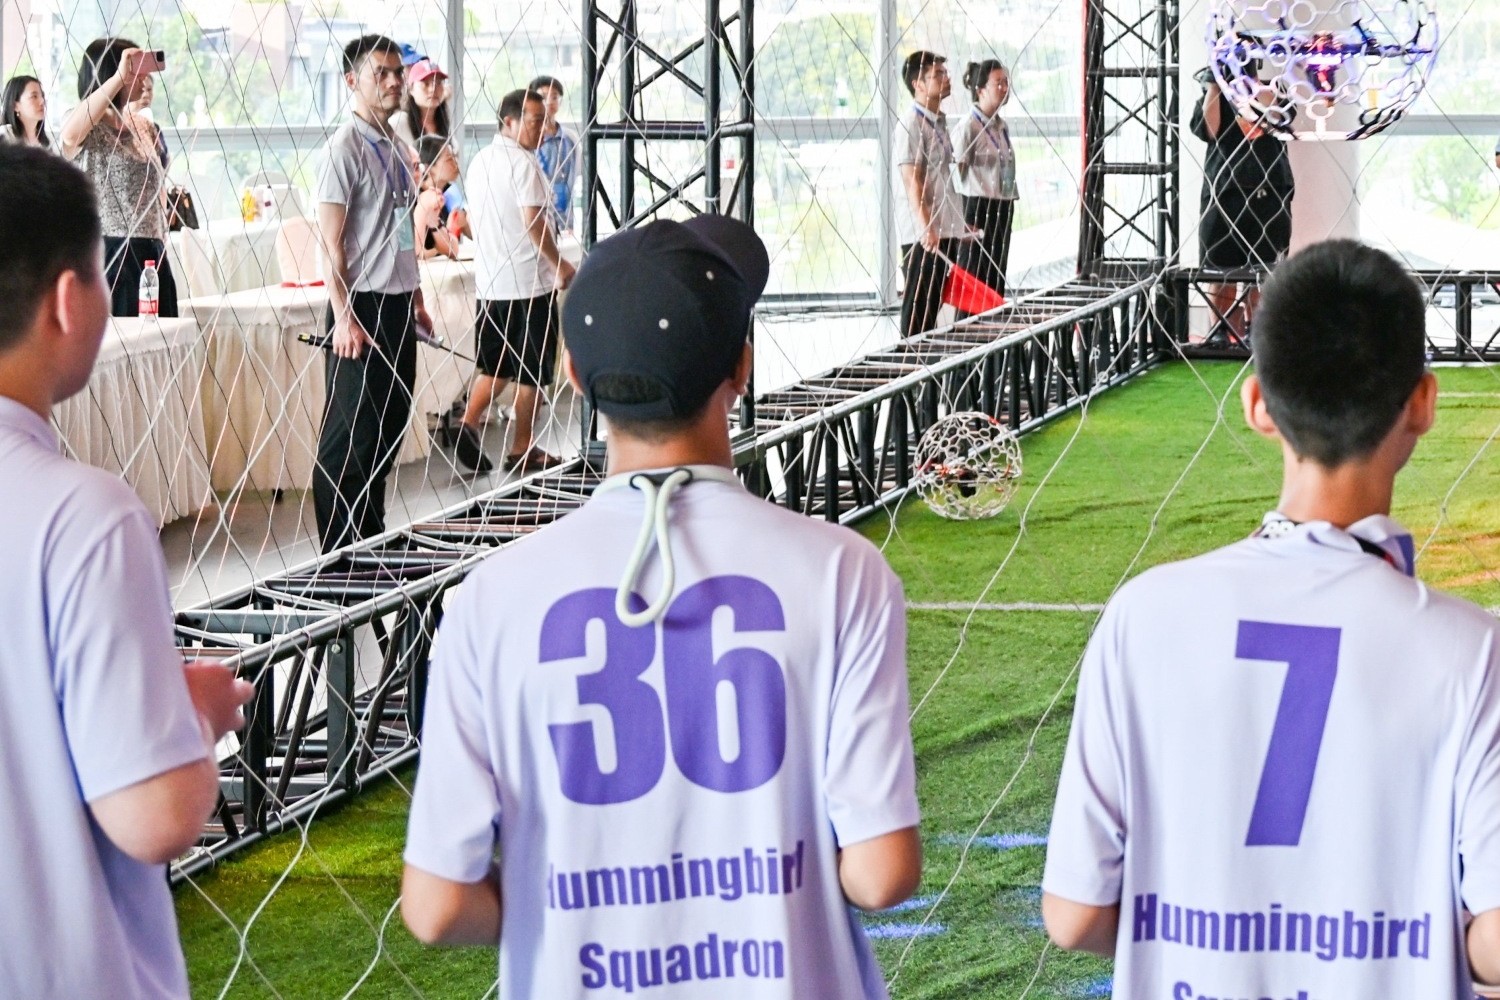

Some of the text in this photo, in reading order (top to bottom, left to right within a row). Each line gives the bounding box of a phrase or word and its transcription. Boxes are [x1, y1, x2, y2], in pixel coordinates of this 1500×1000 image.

[538, 574, 787, 805] 36
[1235, 620, 1342, 847] 7
[579, 933, 785, 994] Squadron
[1132, 892, 1431, 962] Hummingbird
